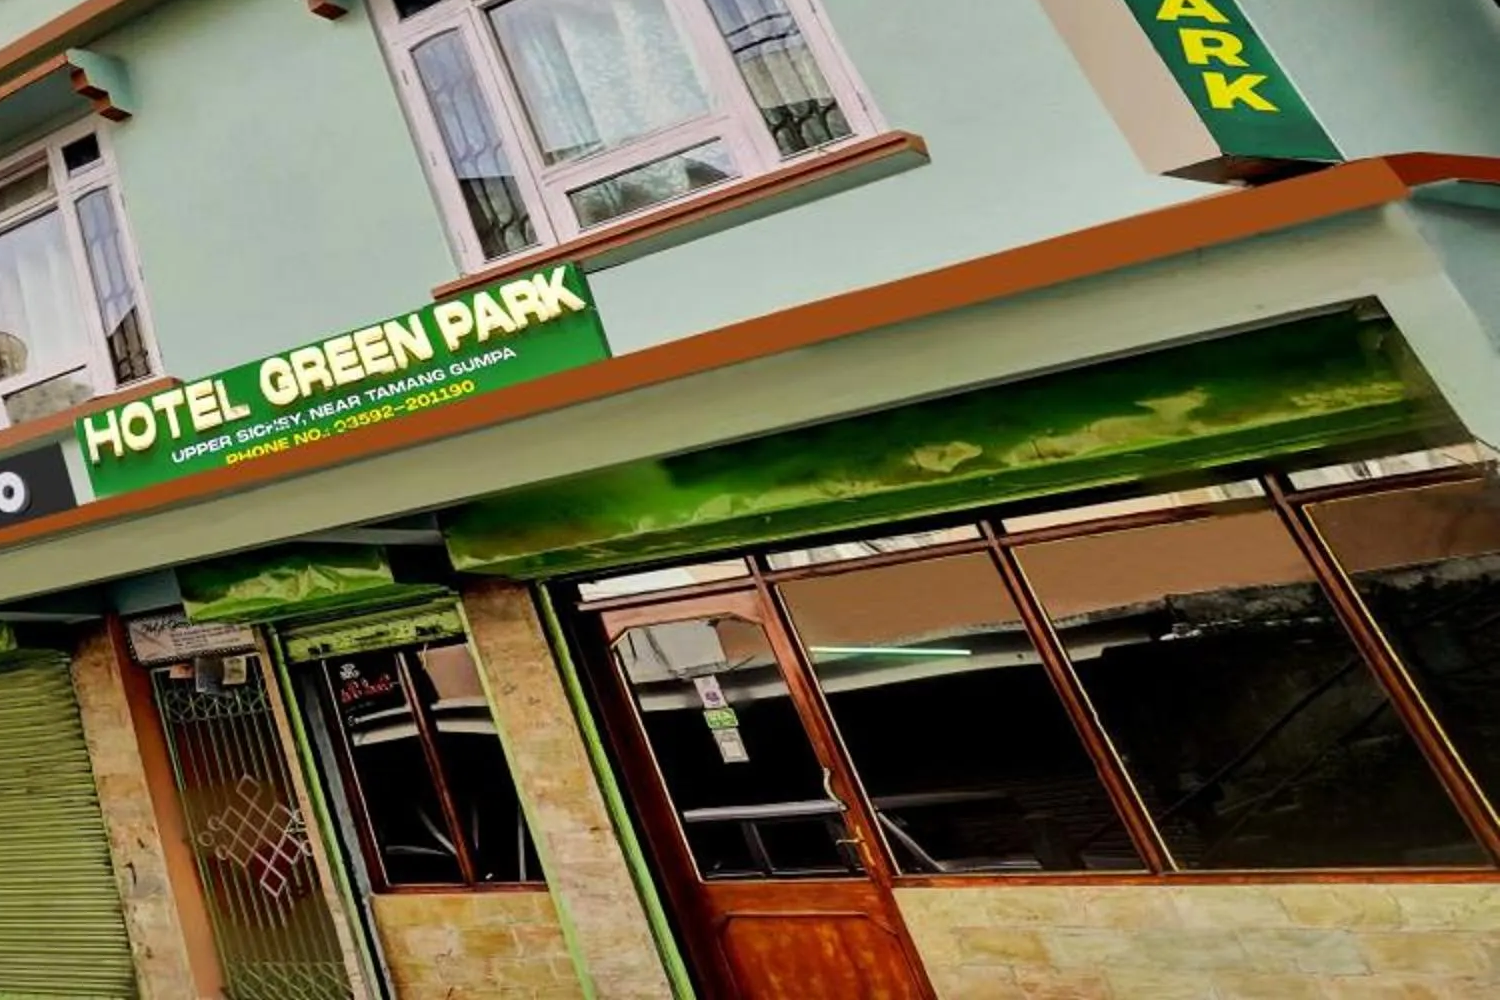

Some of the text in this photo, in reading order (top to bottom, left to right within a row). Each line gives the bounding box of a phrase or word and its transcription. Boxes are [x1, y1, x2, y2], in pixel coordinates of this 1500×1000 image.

[84, 265, 586, 465] HOTEL GREEN PARK
[171, 435, 233, 464] UPPER
[310, 394, 362, 421] NEAR
[364, 369, 446, 402] TAMANG
[449, 346, 517, 376] GUMPA
[225, 437, 290, 466] PHONE
